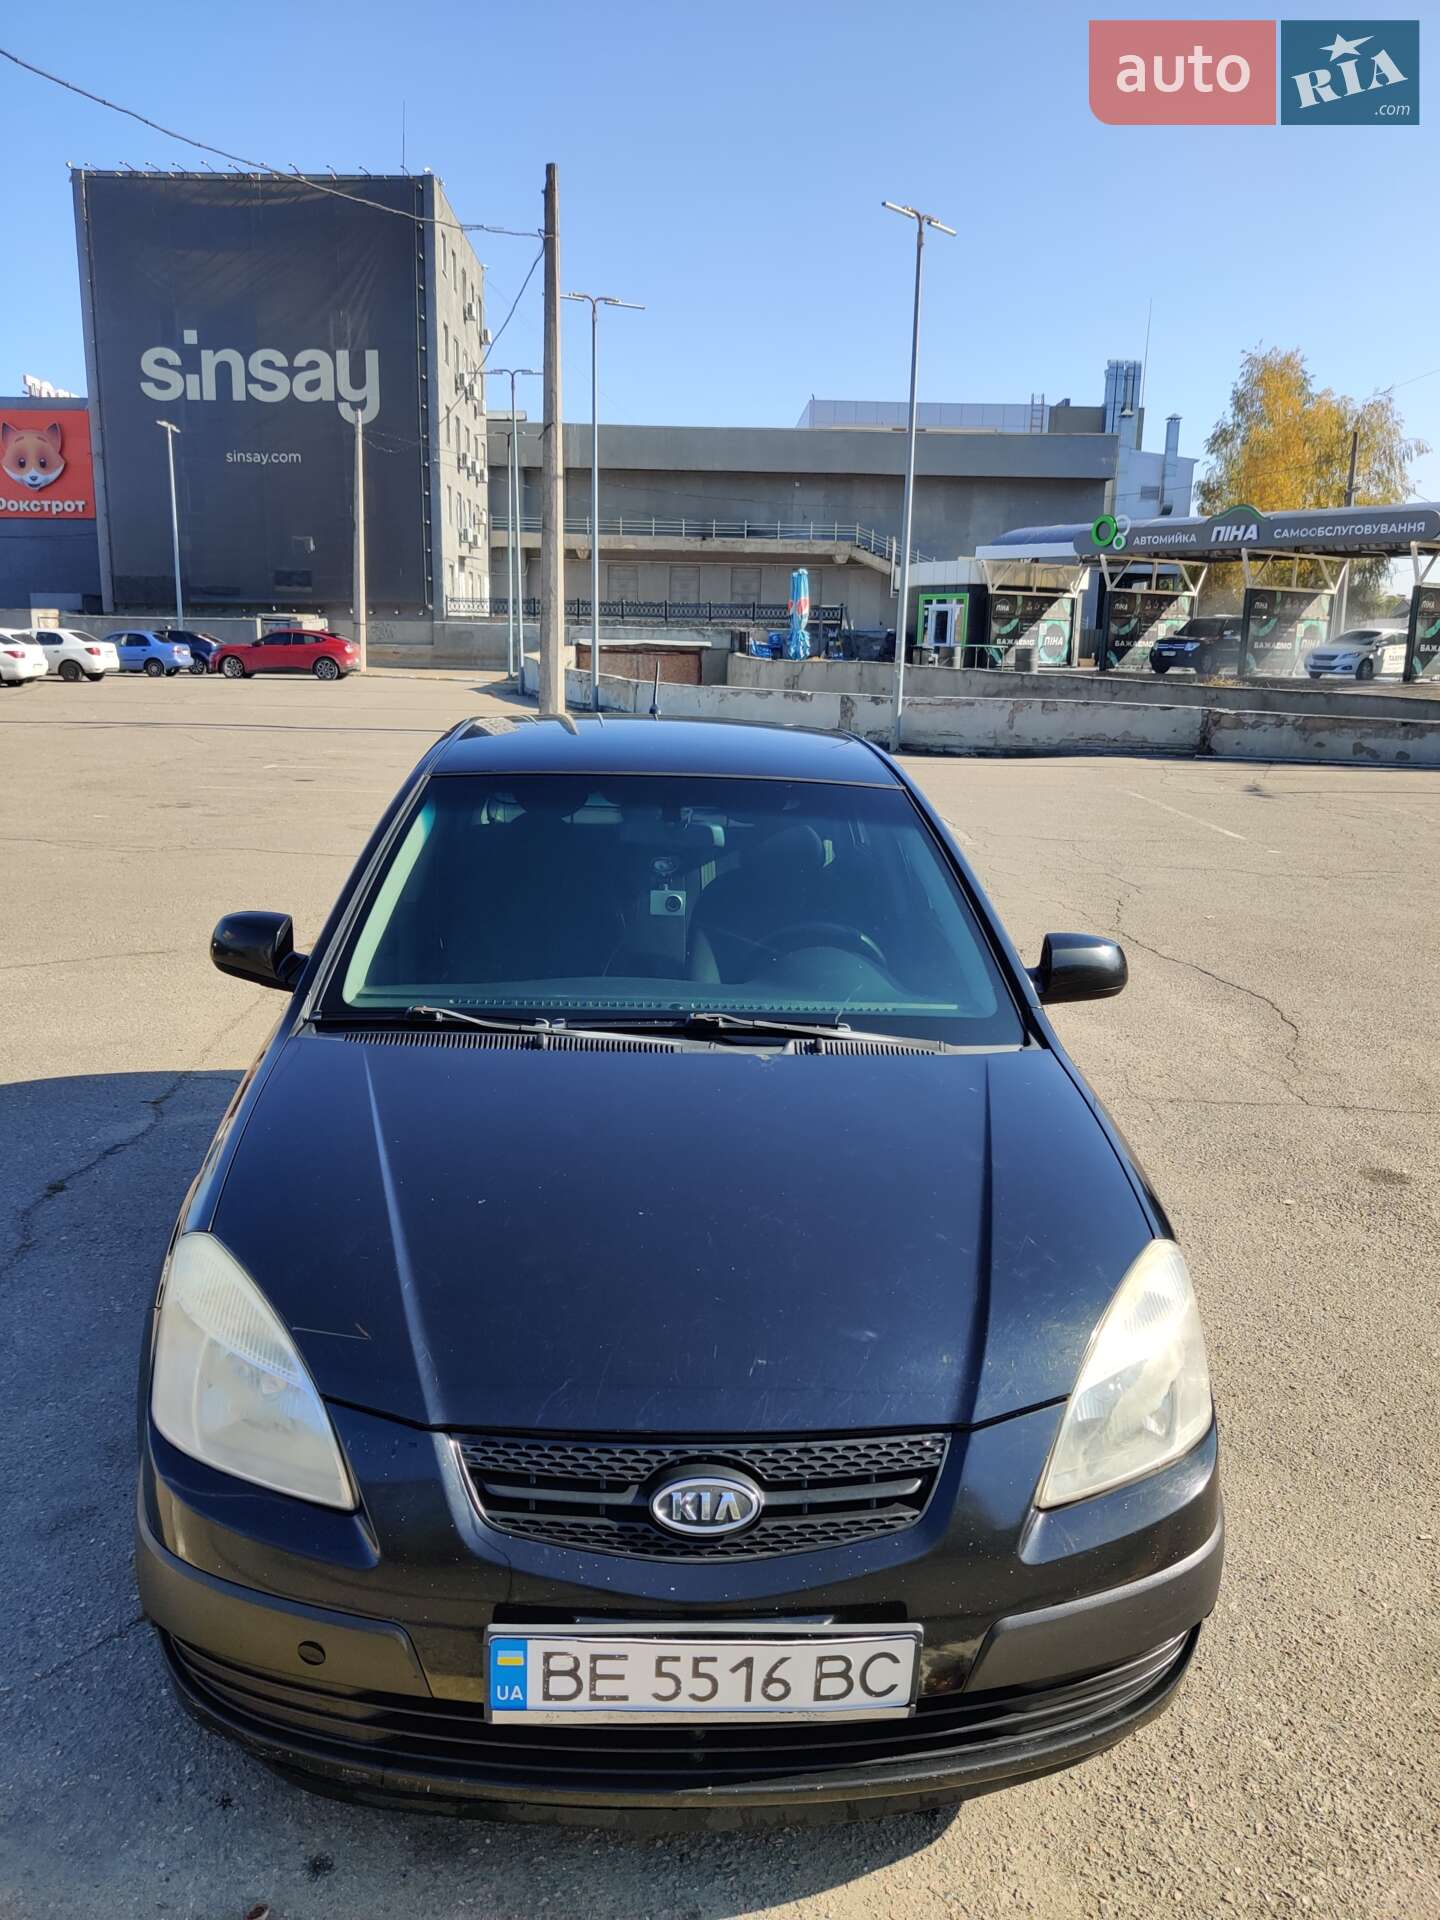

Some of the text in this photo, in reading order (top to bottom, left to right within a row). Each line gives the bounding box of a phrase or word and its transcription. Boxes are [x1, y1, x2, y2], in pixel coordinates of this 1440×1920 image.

[140, 329, 380, 425] sinsay
[226, 450, 302, 465] sinsay.com
[1133, 521, 1426, 546] АВТОМИЙКА ПІНА САМООБСЛУГОВУВАННЯ
[1044, 637, 1064, 646] ПІНА
[671, 1491, 742, 1522] KIA
[542, 1651, 901, 1703] BE 5516 BC
[496, 1685, 524, 1701] UA
